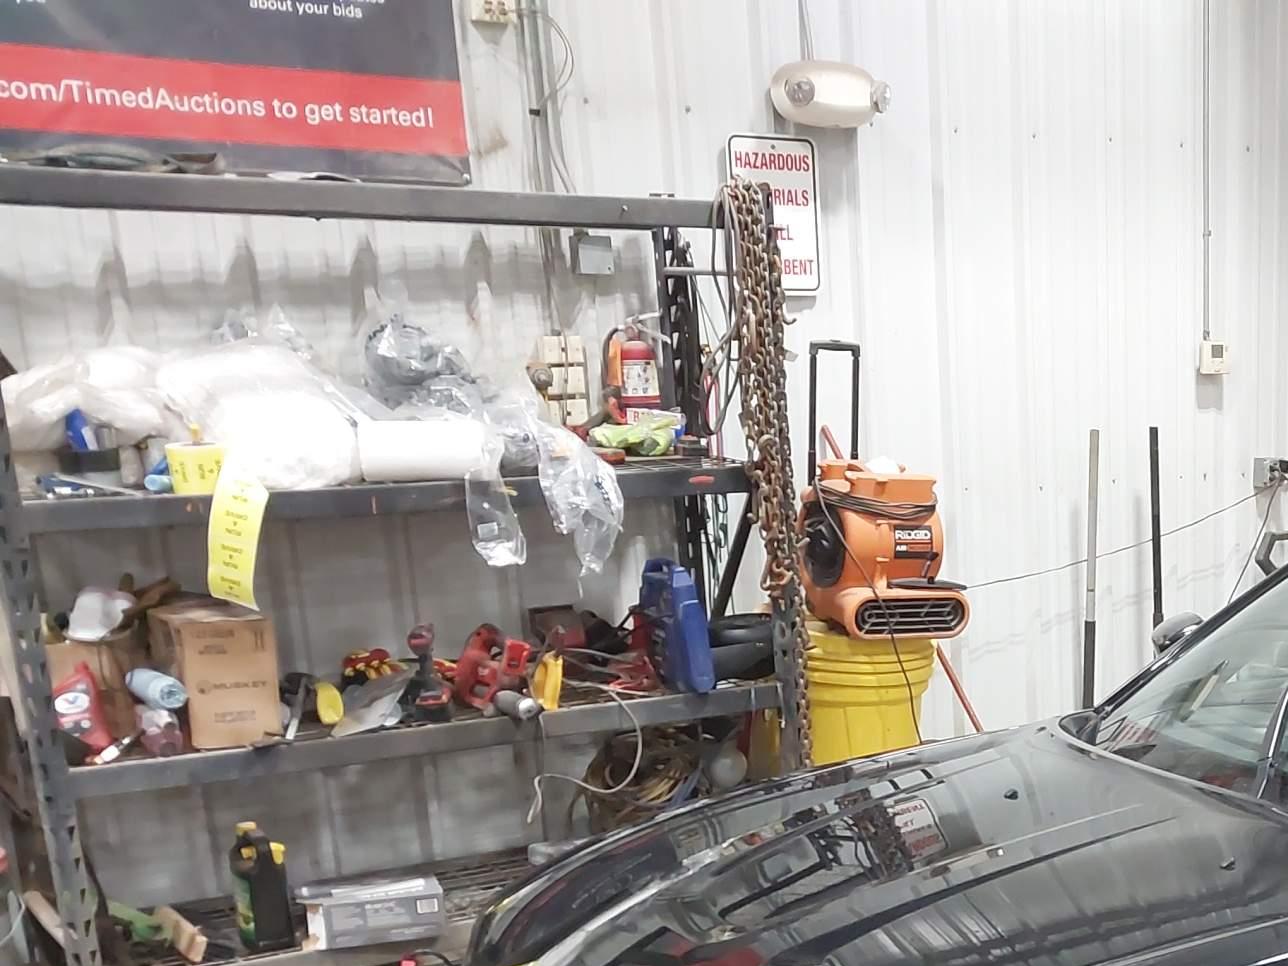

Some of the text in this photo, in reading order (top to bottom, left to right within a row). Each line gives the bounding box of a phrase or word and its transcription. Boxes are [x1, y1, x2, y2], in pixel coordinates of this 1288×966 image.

[250, 0, 363, 19] about your bids
[272, 98, 298, 118] to
[304, 102, 344, 125] get
[349, 104, 435, 128] started!
[734, 151, 811, 172] HAZARDOUS
